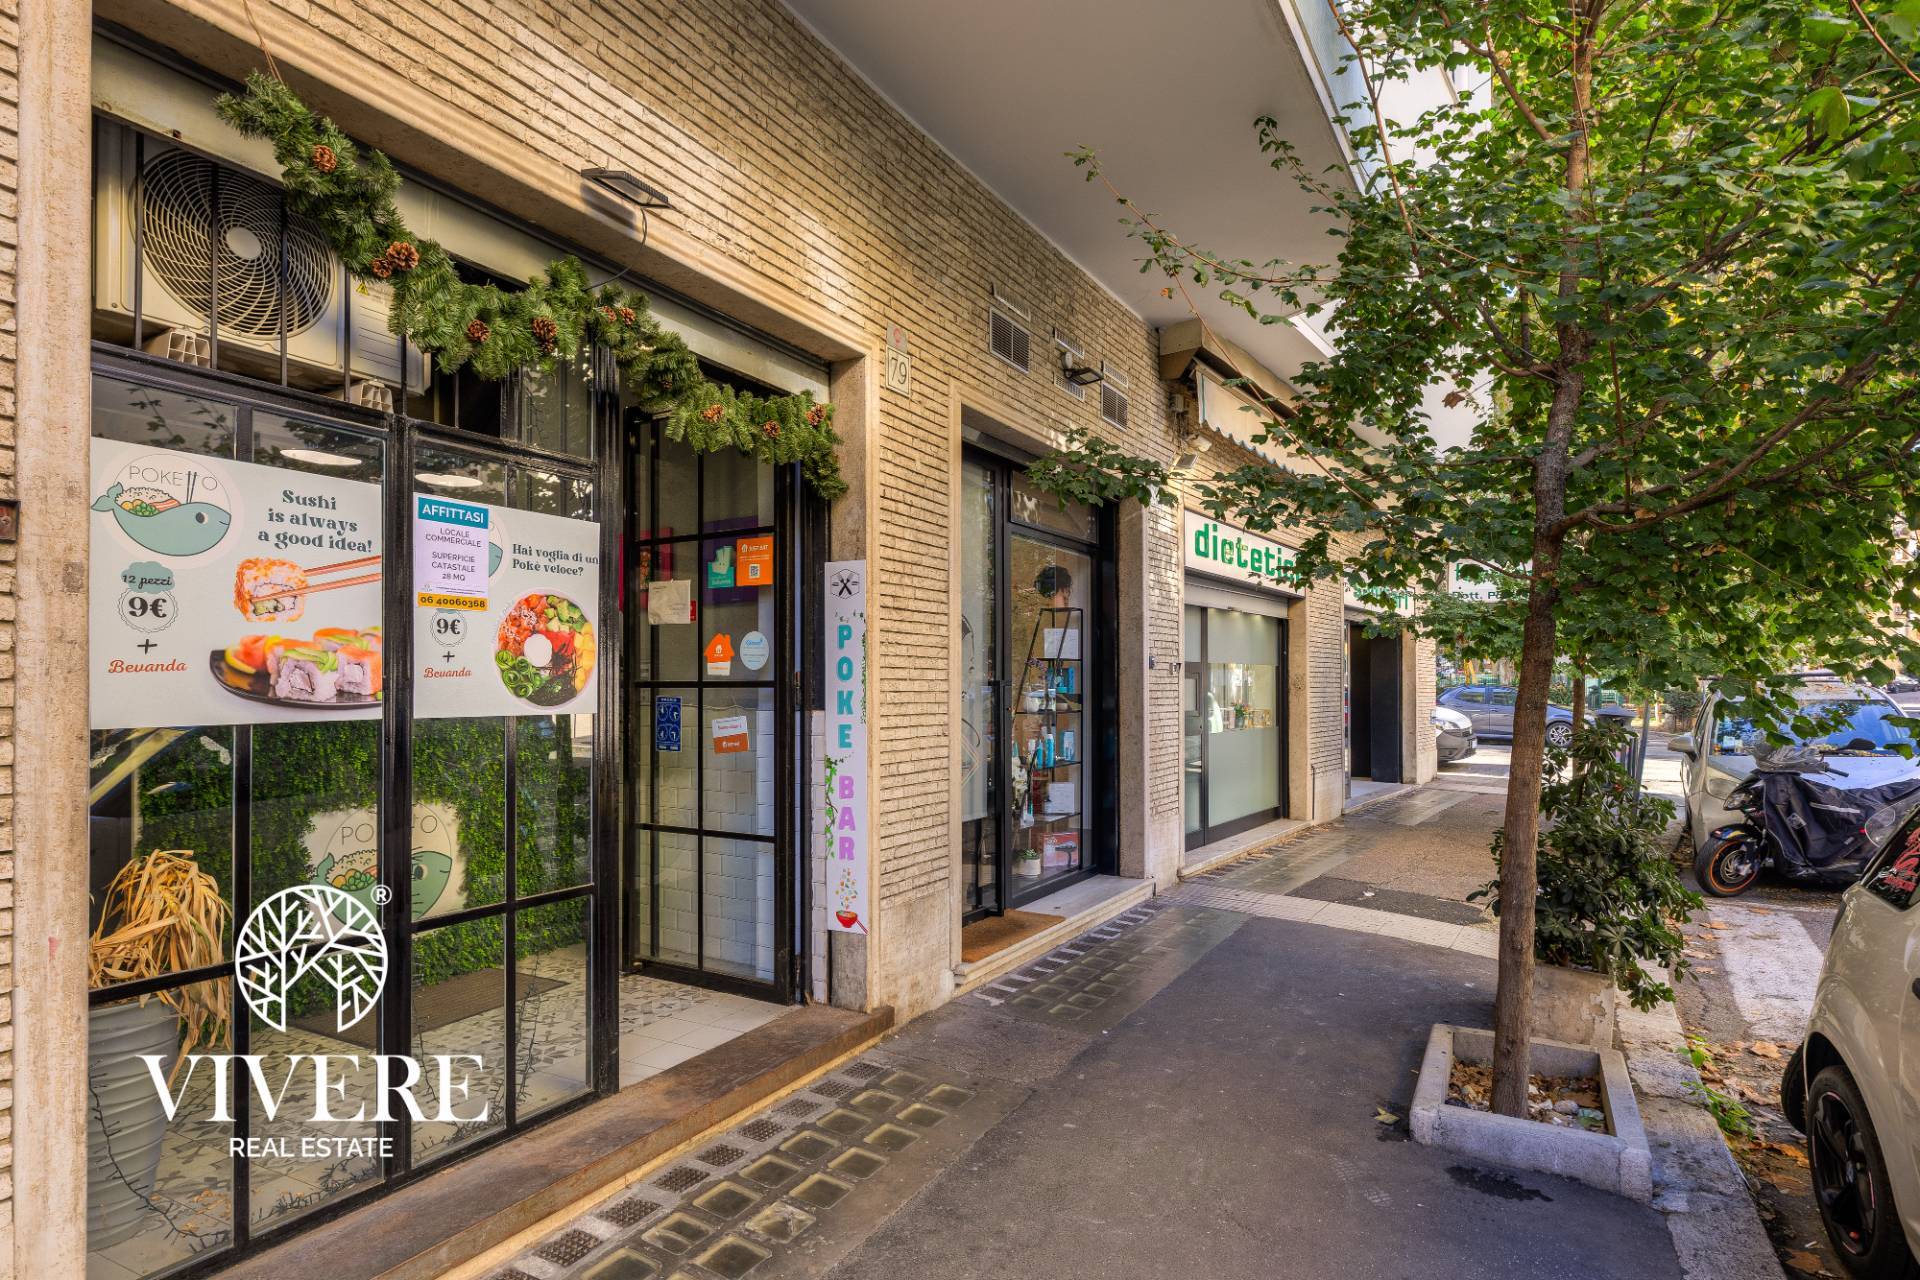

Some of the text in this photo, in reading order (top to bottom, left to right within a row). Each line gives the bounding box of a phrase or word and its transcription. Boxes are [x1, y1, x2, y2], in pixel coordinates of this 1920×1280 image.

[891, 357, 906, 384] 79
[282, 489, 337, 511] Sushi
[422, 504, 484, 524] AFFITTASI
[267, 507, 358, 537] is always
[440, 527, 470, 538] LOCALE
[257, 530, 373, 553] a good idea!
[425, 533, 482, 548] COMMERCIALE
[432, 551, 475, 563] SUPERFICIE
[512, 543, 533, 556] Hai
[536, 549, 570, 563] voglia
[572, 552, 583, 562] di
[431, 561, 476, 573] CATASTALE
[543, 564, 584, 576] veloce?
[123, 575, 173, 589] 12 pezzi
[453, 573, 466, 582] MQ
[128, 596, 167, 618] 9€
[420, 596, 486, 608] 06 40060368
[436, 618, 461, 635] 9€
[108, 659, 187, 673] Bevanda
[424, 666, 472, 678] Bevanda
[836, 624, 855, 861] POKE BAR
